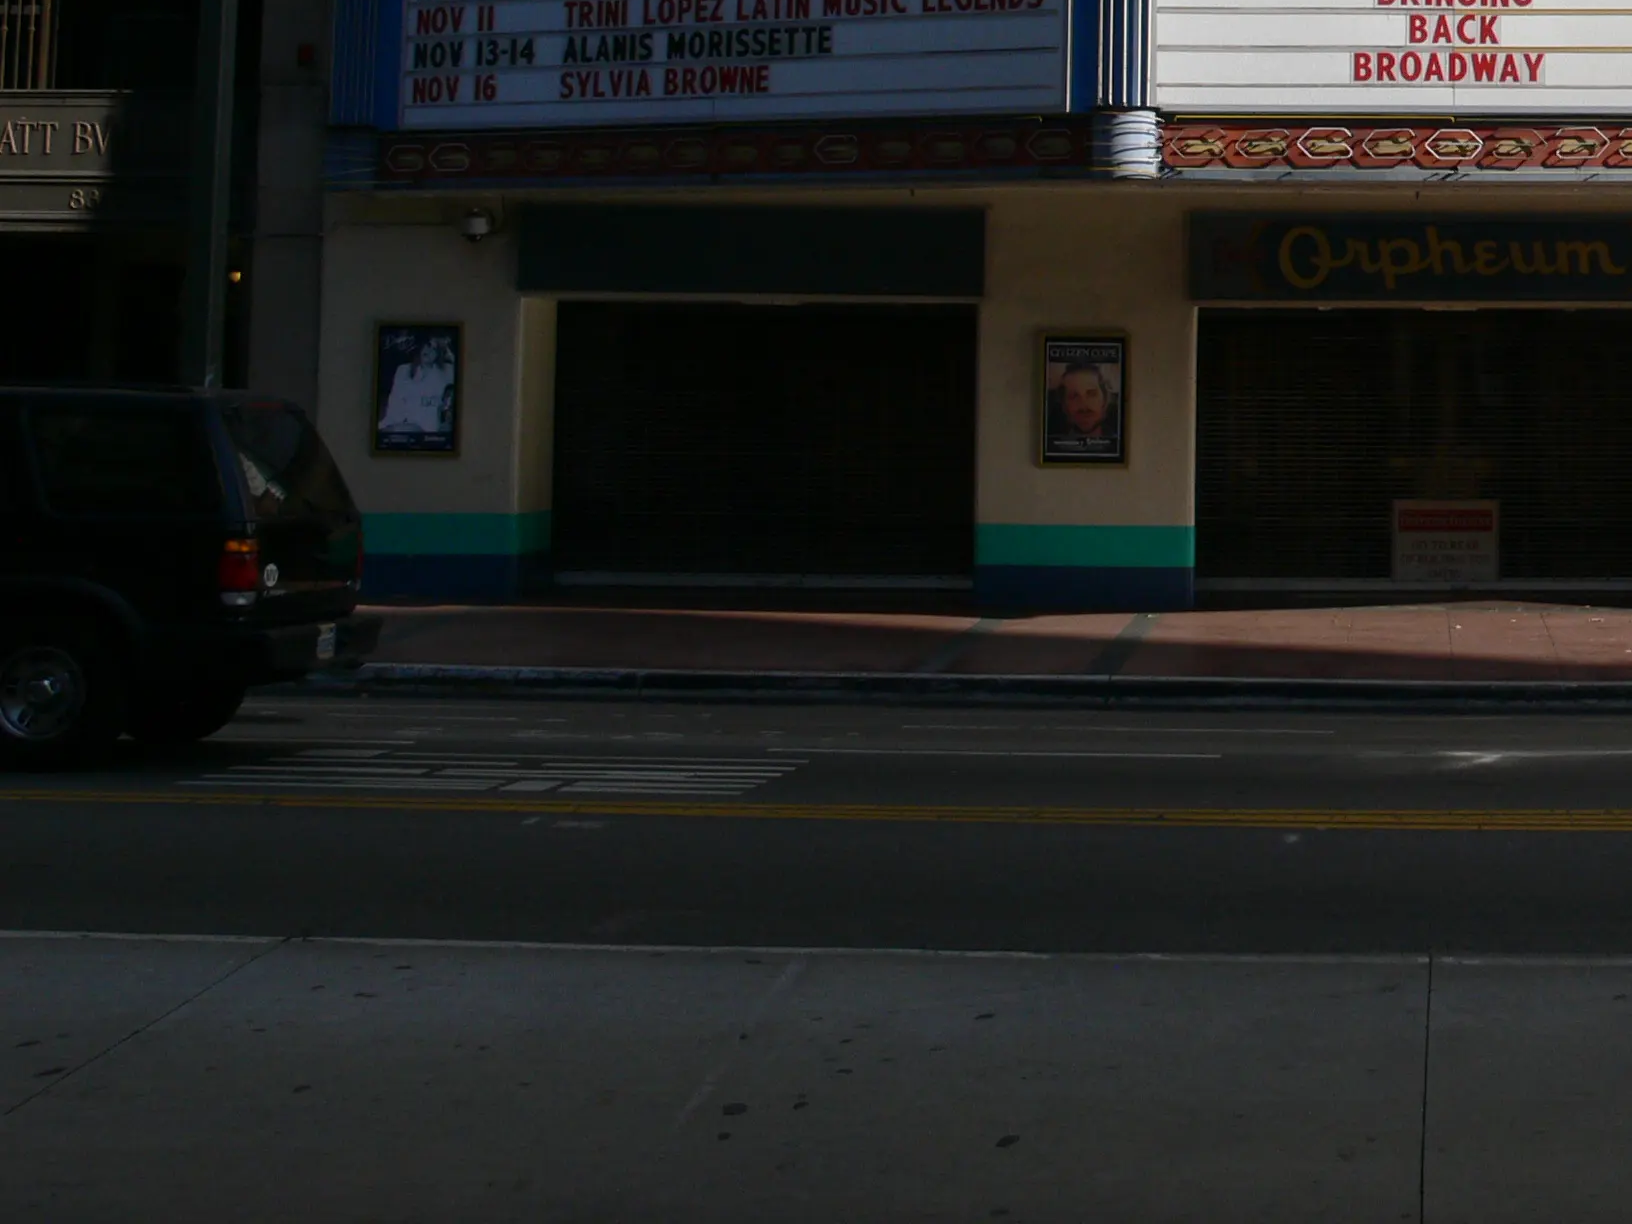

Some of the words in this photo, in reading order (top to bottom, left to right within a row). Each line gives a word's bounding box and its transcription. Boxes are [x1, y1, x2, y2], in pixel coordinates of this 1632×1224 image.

[416, 6, 464, 35] NOV
[478, 5, 495, 32] 11
[564, 0, 628, 28] TRINI
[1408, 14, 1500, 44] BACK
[414, 39, 463, 69] NOV
[476, 37, 536, 67] 13-14
[562, 32, 653, 64] ALANIS
[666, 26, 832, 60] MORISSETTE
[1353, 50, 1545, 82] BROADWAY
[412, 76, 460, 104] NOV
[474, 74, 497, 101] 16
[559, 69, 651, 100] SYLVIA
[664, 65, 769, 96] BROWNE
[1277, 224, 1627, 290] Orpheum
